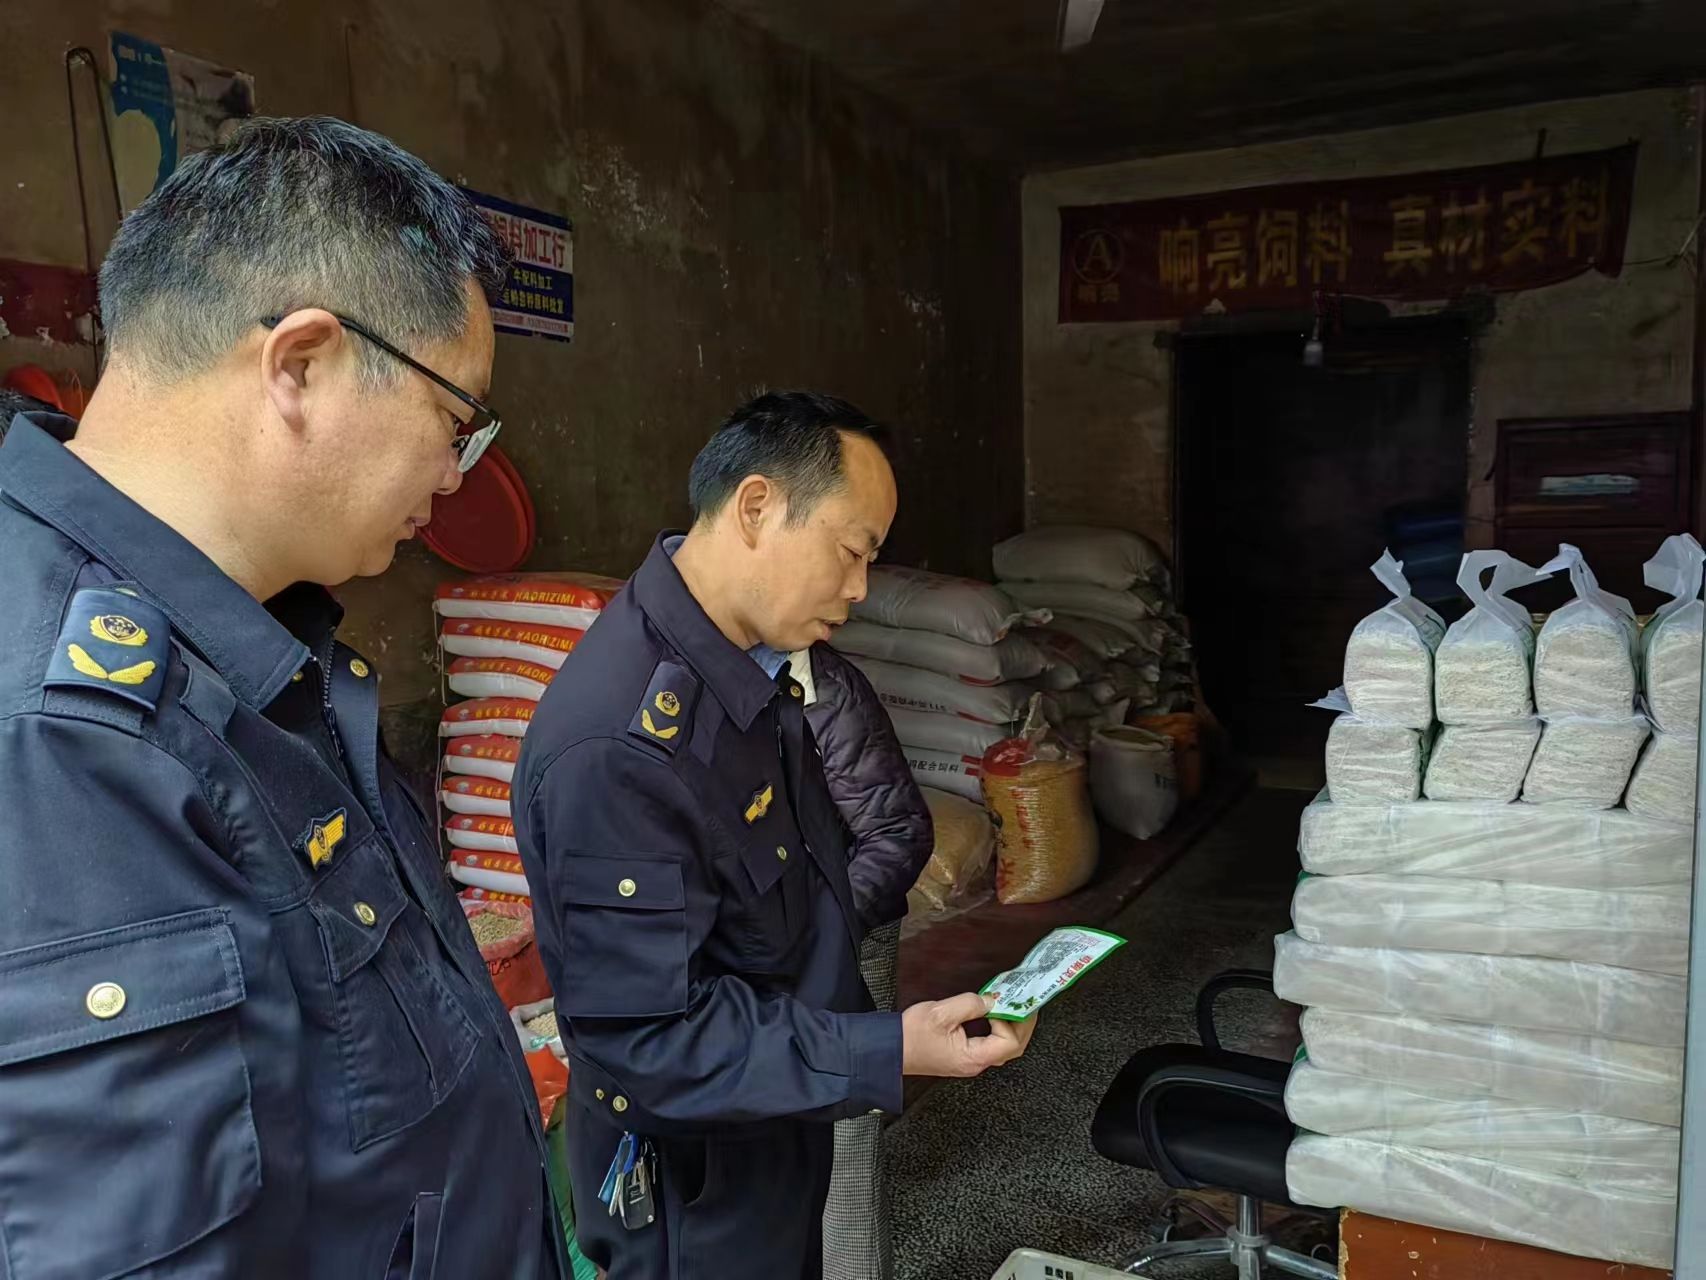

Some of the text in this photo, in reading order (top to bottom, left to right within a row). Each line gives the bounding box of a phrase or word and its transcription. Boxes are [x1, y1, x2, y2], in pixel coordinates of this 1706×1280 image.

[1158, 176, 1606, 294] 响亮饲料 真材实料
[514, 591, 576, 605] HAORIZIMI
[516, 631, 574, 651] HAORIZIMI
